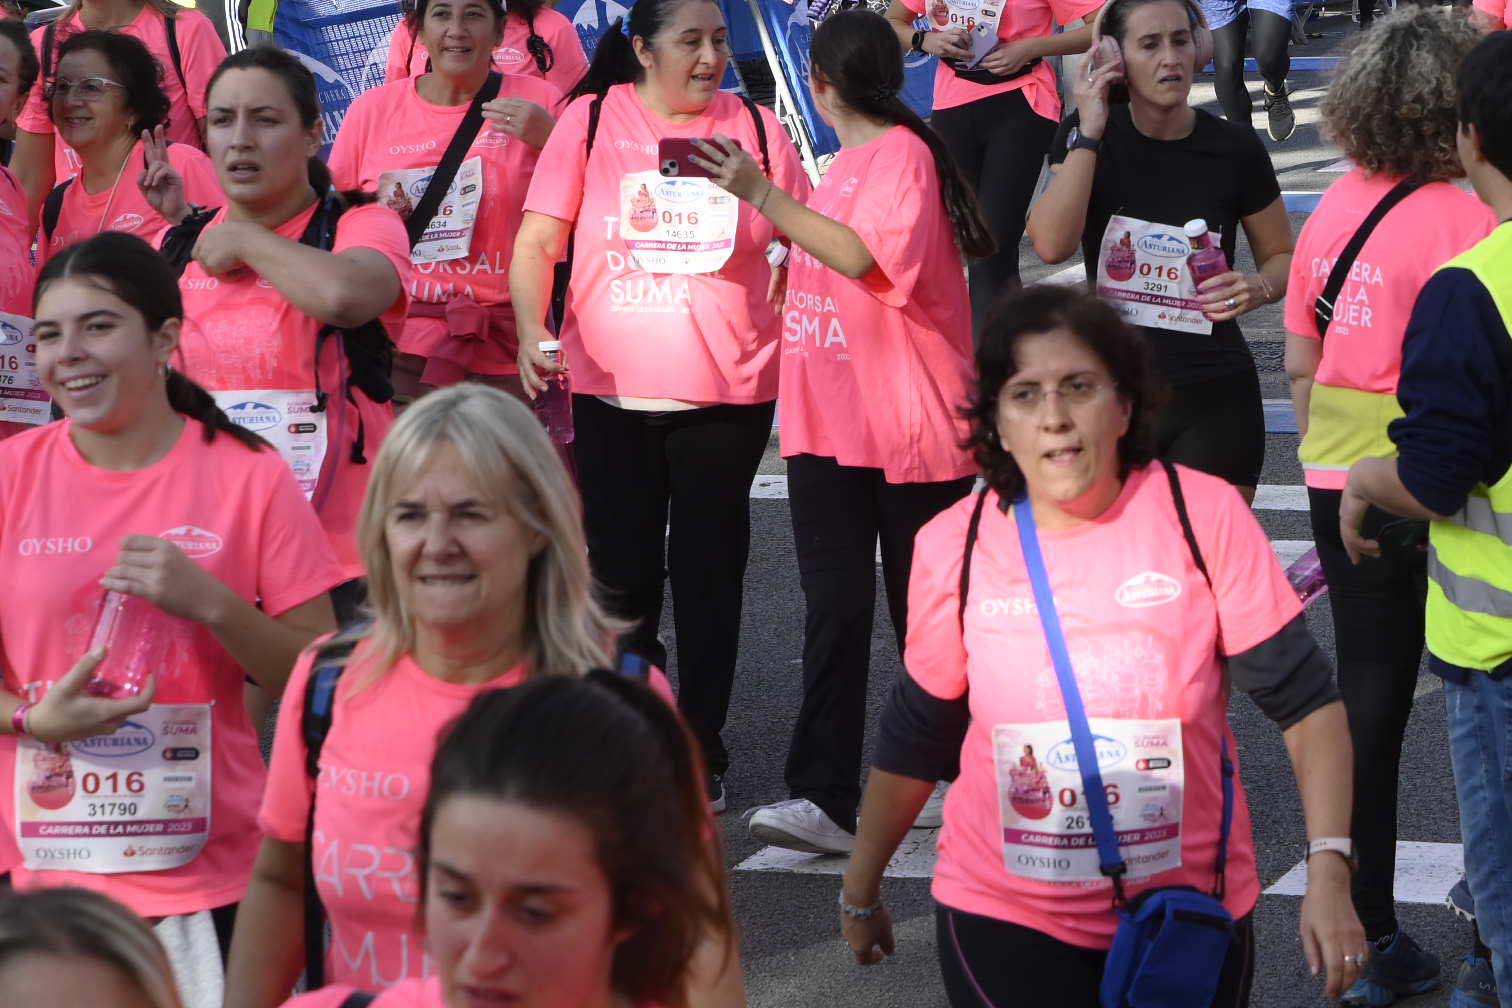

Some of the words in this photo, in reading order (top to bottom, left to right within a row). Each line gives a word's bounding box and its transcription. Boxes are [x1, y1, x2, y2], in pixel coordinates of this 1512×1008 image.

[950, 13, 975, 25] 016
[389, 140, 437, 156] OYSHO
[662, 211, 699, 225] 016
[1143, 239, 1185, 255] ASTURIANA
[412, 252, 505, 275] ORSAL
[1139, 262, 1180, 280] 016
[609, 279, 691, 305] SUMA
[1143, 281, 1168, 293] 3291
[1347, 286, 1369, 304] LA
[1333, 302, 1373, 327] UJER
[231, 415, 277, 425] STURIANA
[19, 536, 93, 557] OYSHO
[161, 724, 198, 737] SUMA
[81, 771, 146, 795] 016
[320, 763, 410, 800] YSHO
[1058, 784, 1121, 808] 06
[87, 802, 138, 817] 31790
[38, 823, 89, 835] CARRERA
[90, 823, 107, 835] DE
[109, 823, 124, 835] LA
[125, 823, 164, 834] MUJER
[1021, 833, 1068, 847] CARRERA
[1070, 835, 1085, 846] DE
[35, 847, 91, 861] OYSHO
[137, 844, 195, 859] Santander
[1124, 850, 1170, 866] antander
[1018, 854, 1071, 871] OYSHO
